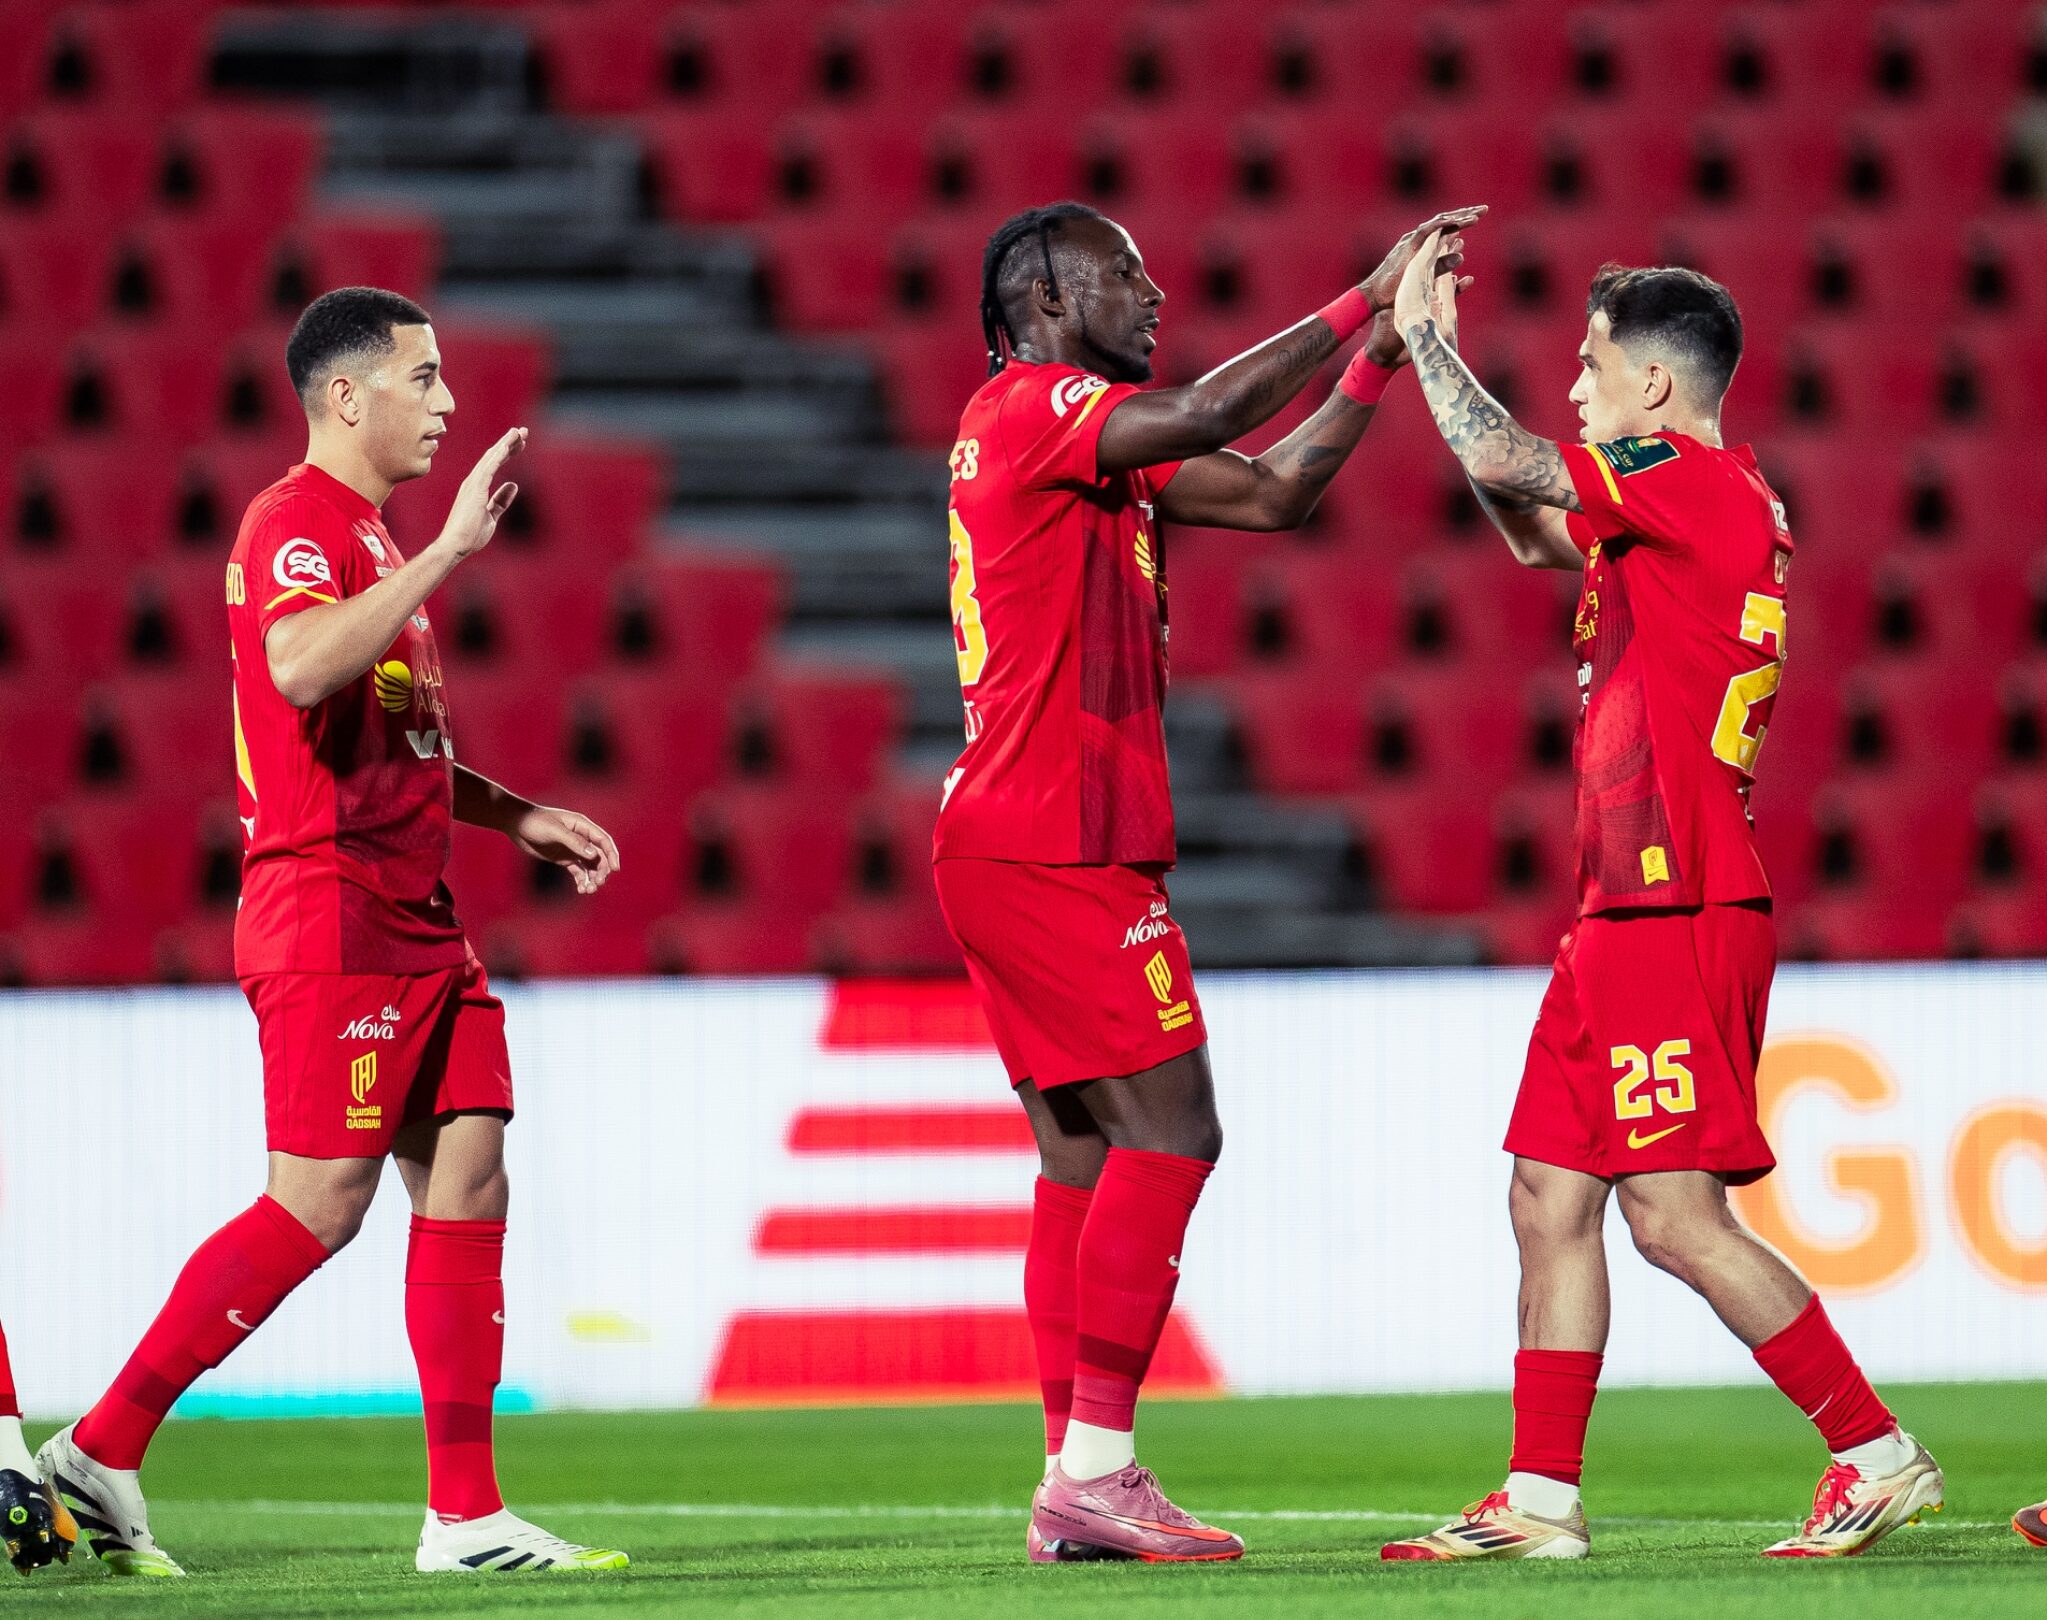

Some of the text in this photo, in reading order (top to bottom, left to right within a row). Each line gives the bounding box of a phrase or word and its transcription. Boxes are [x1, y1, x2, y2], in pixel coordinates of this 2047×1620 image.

[1120, 915, 1170, 949] Nova
[337, 1014, 396, 1040] Nova
[1610, 1038, 1697, 1120] 25
